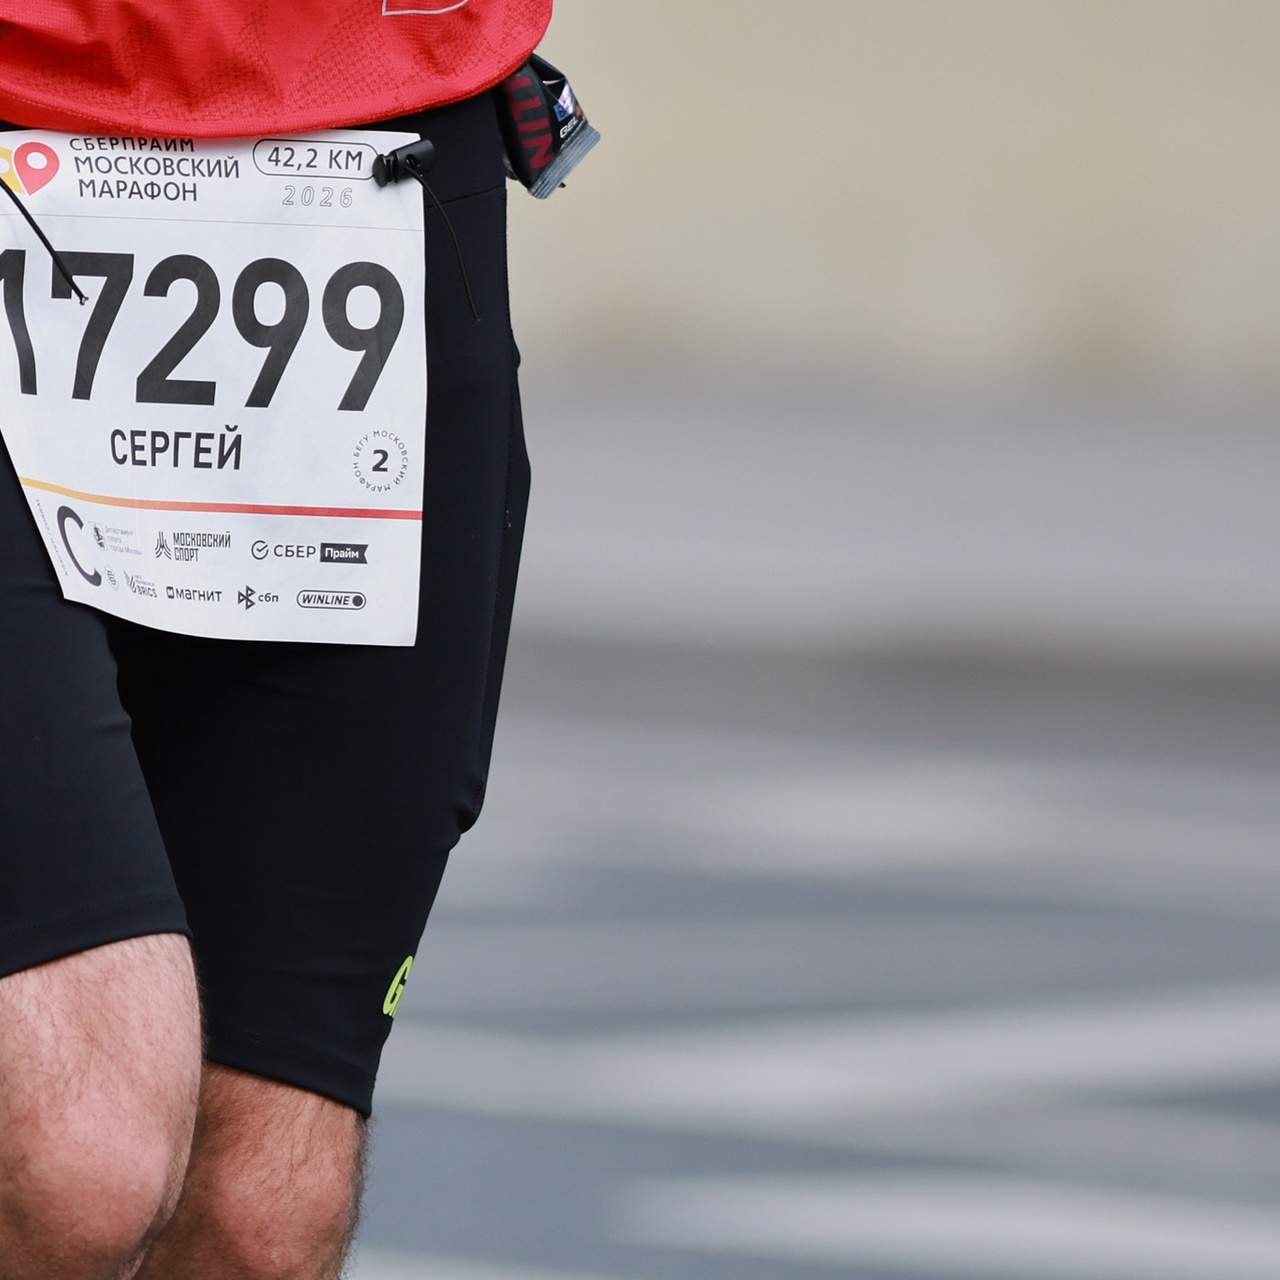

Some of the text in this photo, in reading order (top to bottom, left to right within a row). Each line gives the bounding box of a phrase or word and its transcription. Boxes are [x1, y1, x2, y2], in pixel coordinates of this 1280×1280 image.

[73, 155, 240, 179] МОСКОВСКИЙ
[267, 146, 318, 171] 42,2
[78, 179, 198, 202] МАРАФОН
[282, 185, 353, 208] 2026
[110, 424, 242, 470] СЕРГЕЙ
[373, 430, 409, 485] МОСКОВСКИЙ
[372, 448, 389, 472] 2
[352, 462, 391, 493] МАРАФОН
[173, 531, 231, 548] МОСКОВСКИЙ
[174, 547, 199, 562] СПОРТ
[273, 544, 359, 559] СБЕР Прайм
[258, 593, 279, 603] сбп
[301, 594, 350, 606] WINLINE
